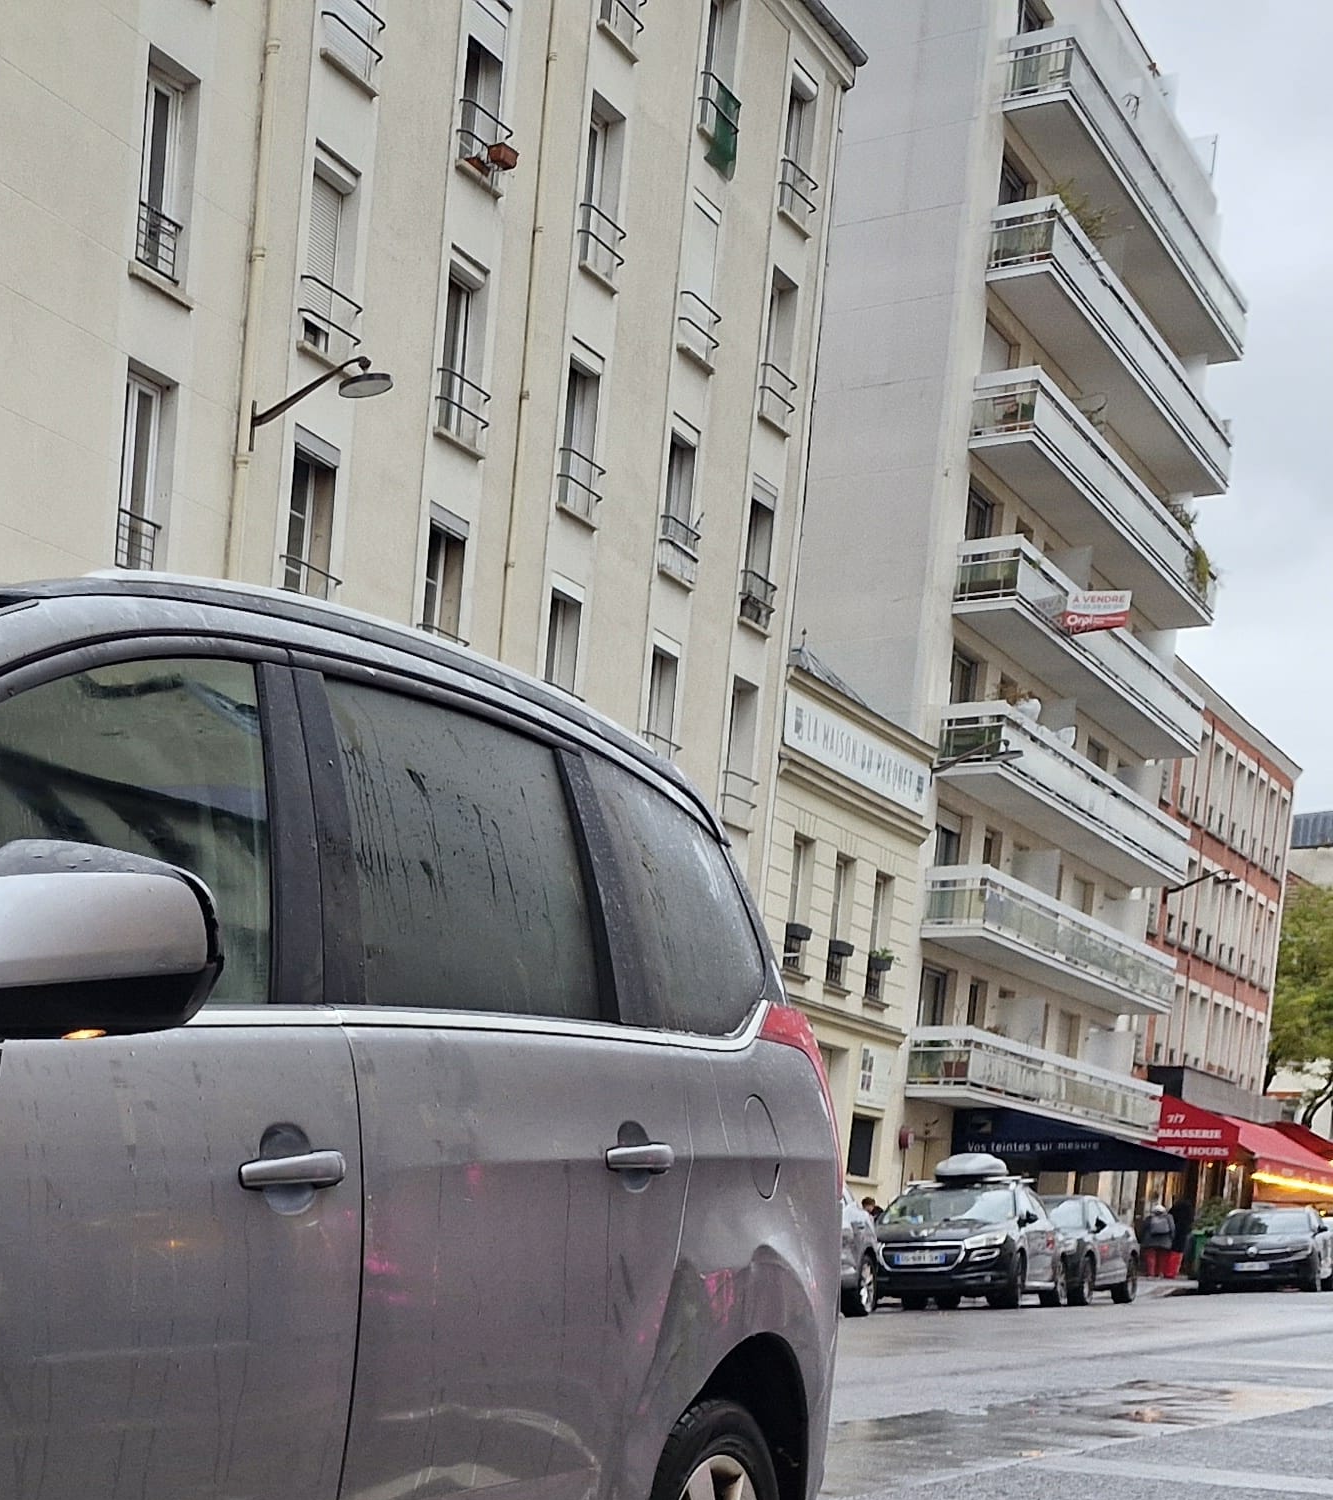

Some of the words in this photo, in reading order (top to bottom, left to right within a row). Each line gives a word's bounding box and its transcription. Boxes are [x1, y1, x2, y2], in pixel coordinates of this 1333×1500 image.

[1083, 595, 1125, 603] VENDRE
[822, 723, 858, 766] MAISON
[1157, 1128, 1222, 1139] BRASSERIE
[968, 1142, 986, 1152] Vos
[1188, 1146, 1229, 1157] HOURS
